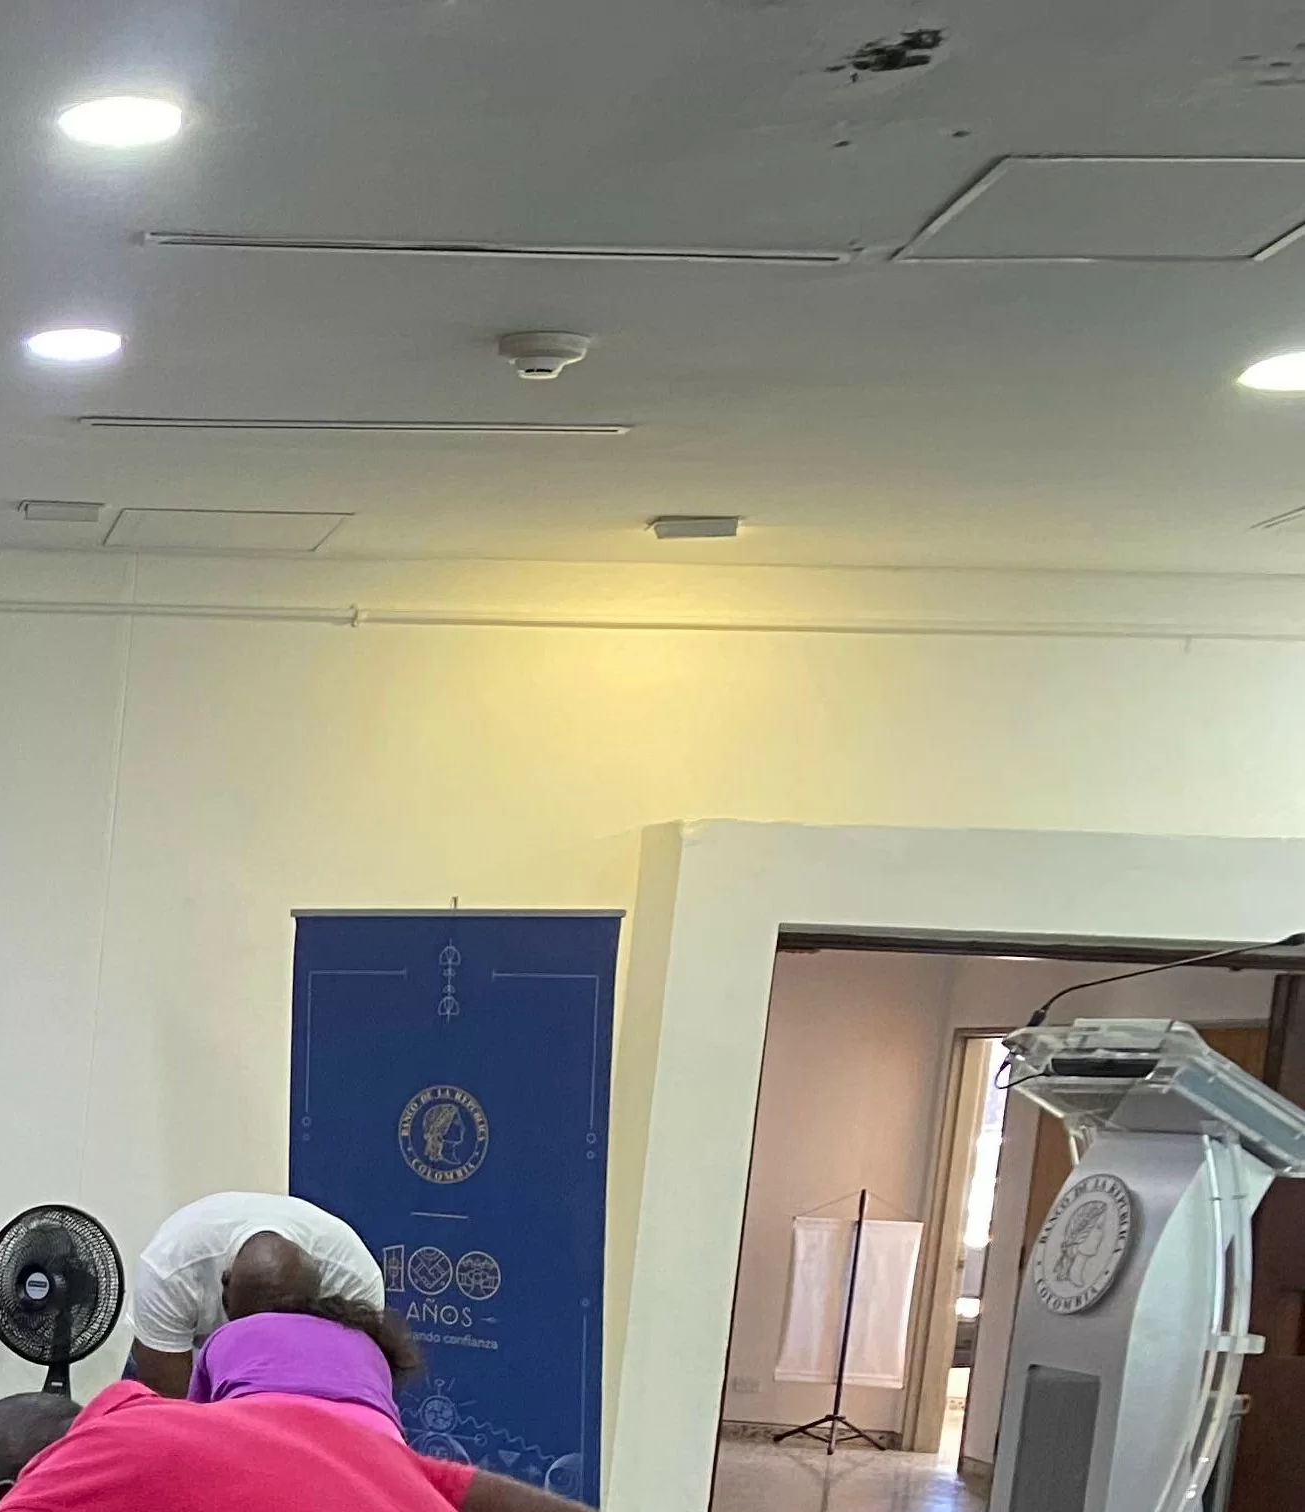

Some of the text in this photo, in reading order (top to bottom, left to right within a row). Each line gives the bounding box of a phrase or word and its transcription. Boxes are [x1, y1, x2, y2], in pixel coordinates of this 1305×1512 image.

[401, 1103, 419, 1136] BANCO
[421, 1091, 431, 1104] DE
[437, 1087, 451, 1098] LA
[411, 1159, 475, 1181] COLOMBIA
[1039, 1198, 1070, 1244] BANCO
[1074, 1182, 1087, 1198] DE
[1036, 1279, 1099, 1310] COLOMBIA
[406, 1298, 473, 1327] AÑOS
[443, 1334, 498, 1350] confianza
